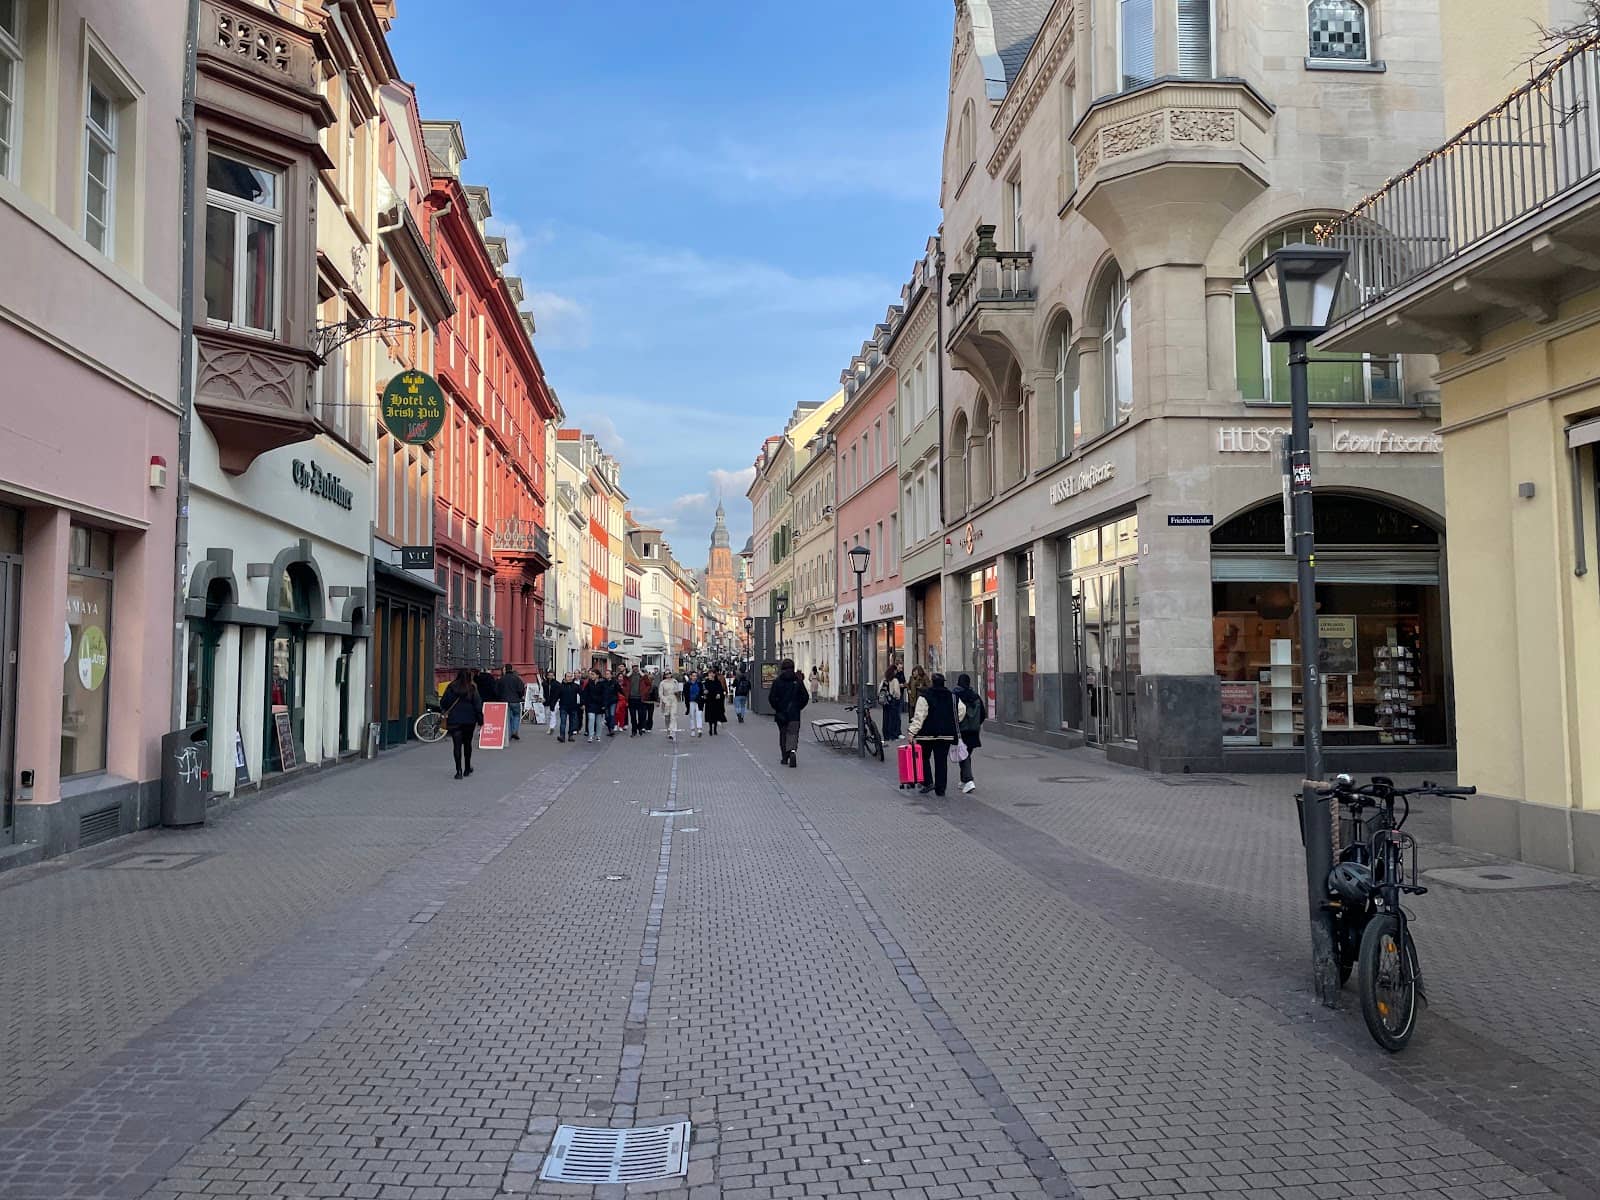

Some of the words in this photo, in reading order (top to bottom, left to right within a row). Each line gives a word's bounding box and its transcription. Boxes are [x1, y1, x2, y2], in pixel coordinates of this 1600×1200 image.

[390, 394, 424, 406] Hotel
[427, 396, 438, 406] &
[386, 406, 414, 418] Irish
[416, 407, 440, 419] Pub
[310, 460, 354, 511] Dubliner
[408, 551, 429, 560] VIU
